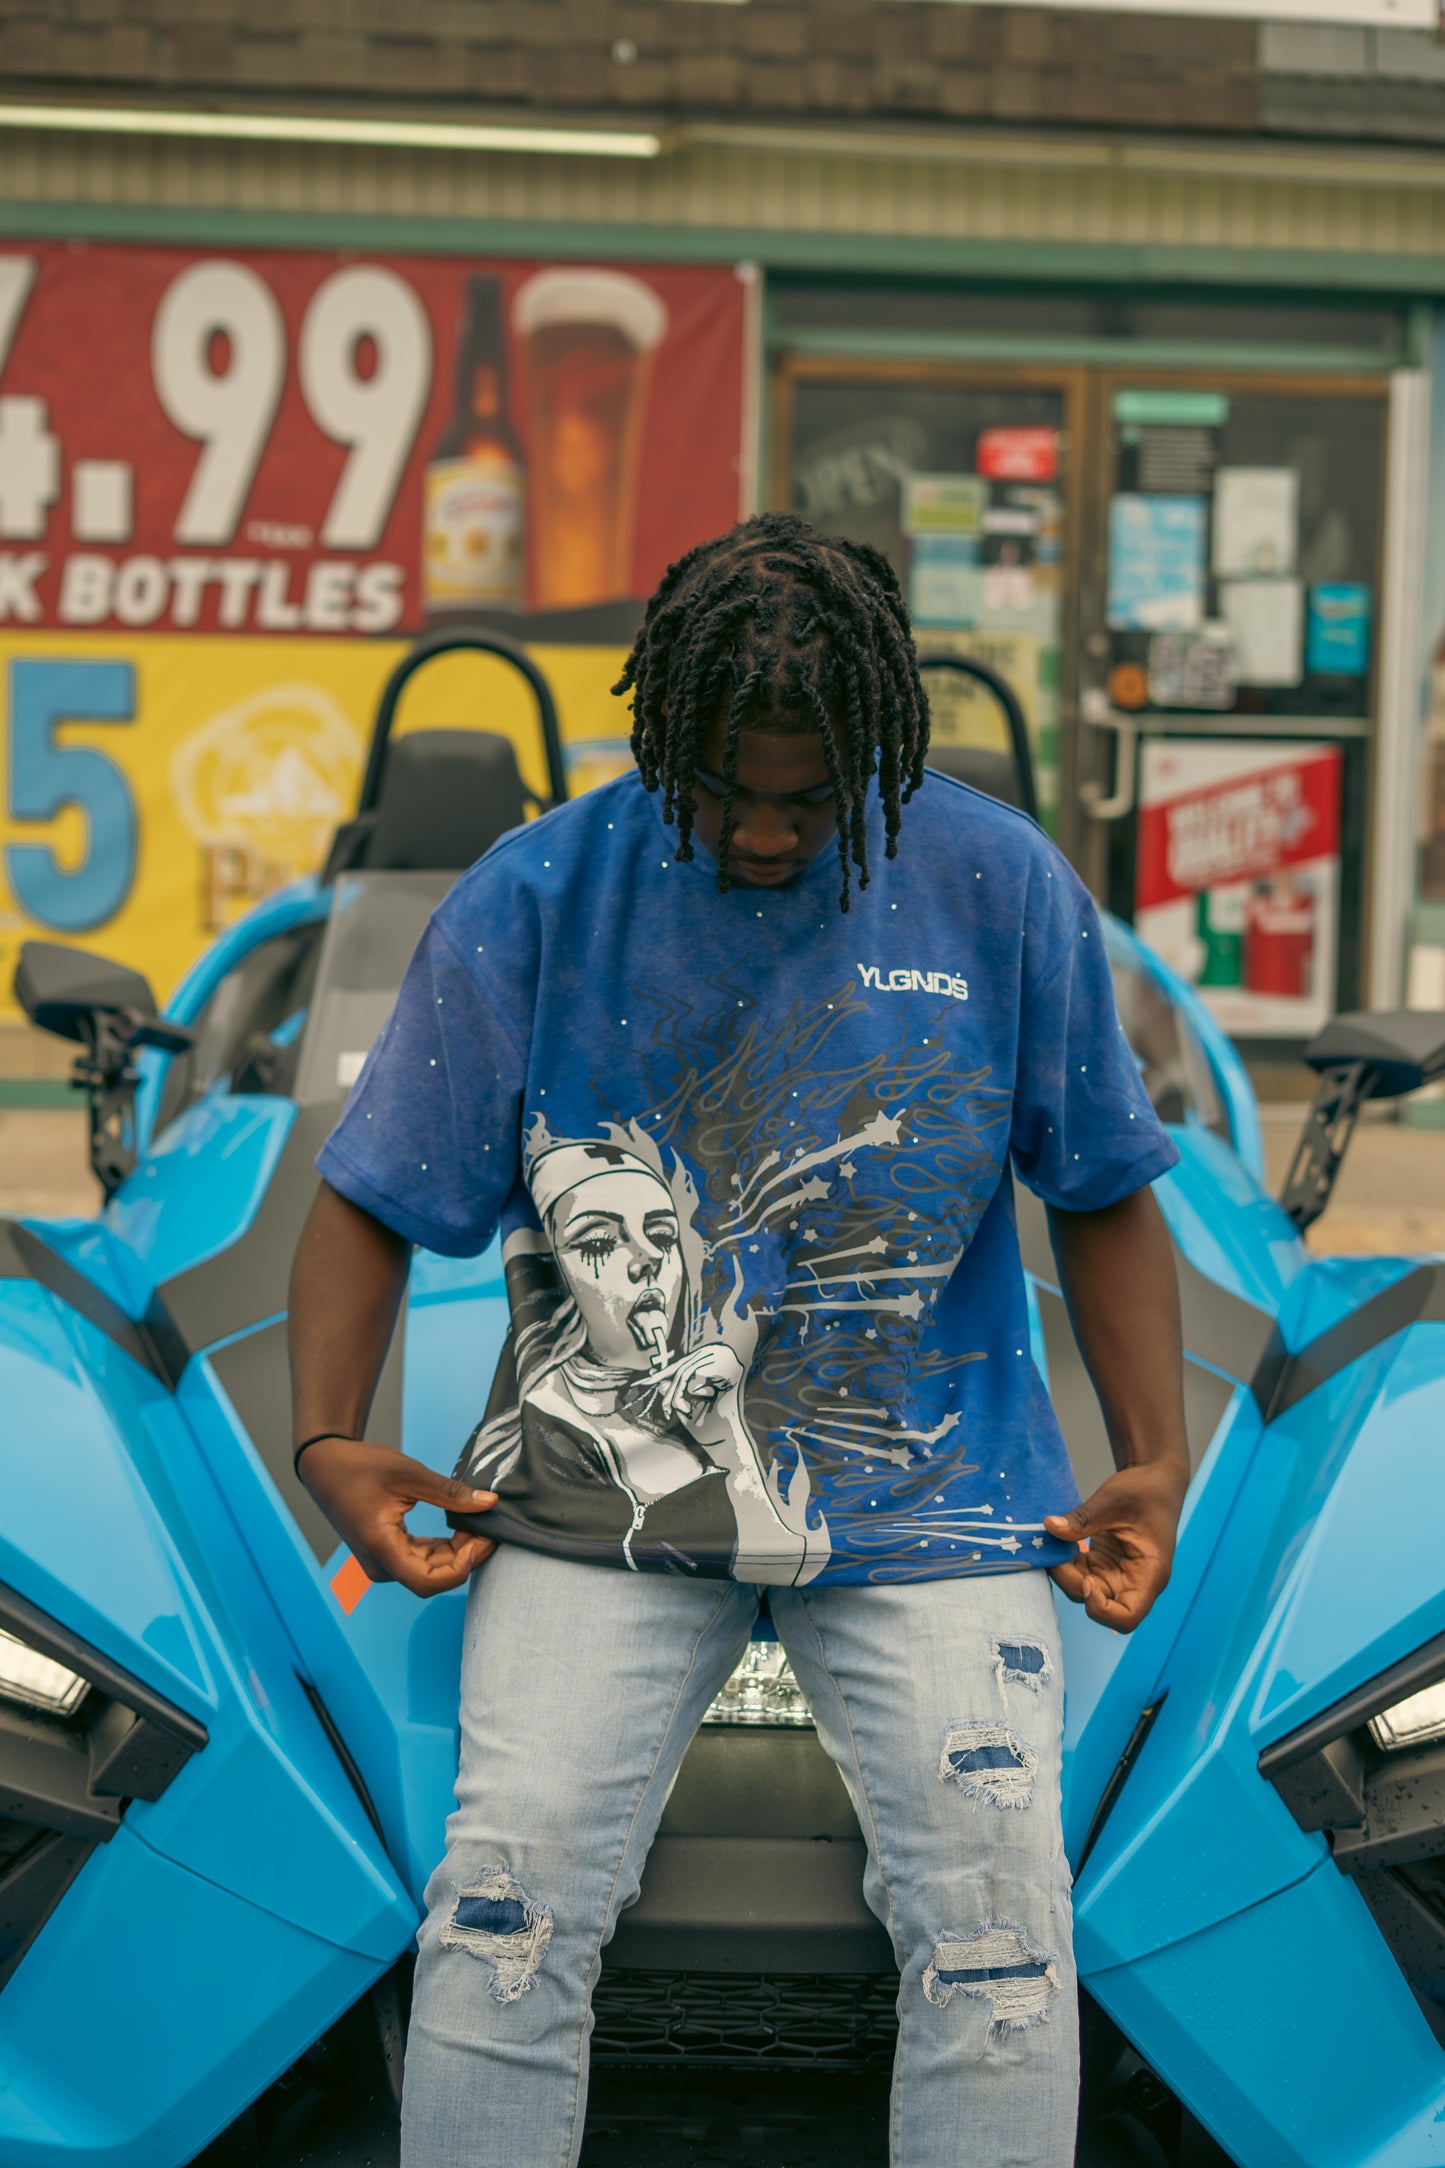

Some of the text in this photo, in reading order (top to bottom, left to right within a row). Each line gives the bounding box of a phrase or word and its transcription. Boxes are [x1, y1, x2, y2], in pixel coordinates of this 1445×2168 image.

[59, 554, 405, 633] BOTTLES
[5, 659, 138, 933] 5
[857, 963, 968, 1001] YLGNDS
